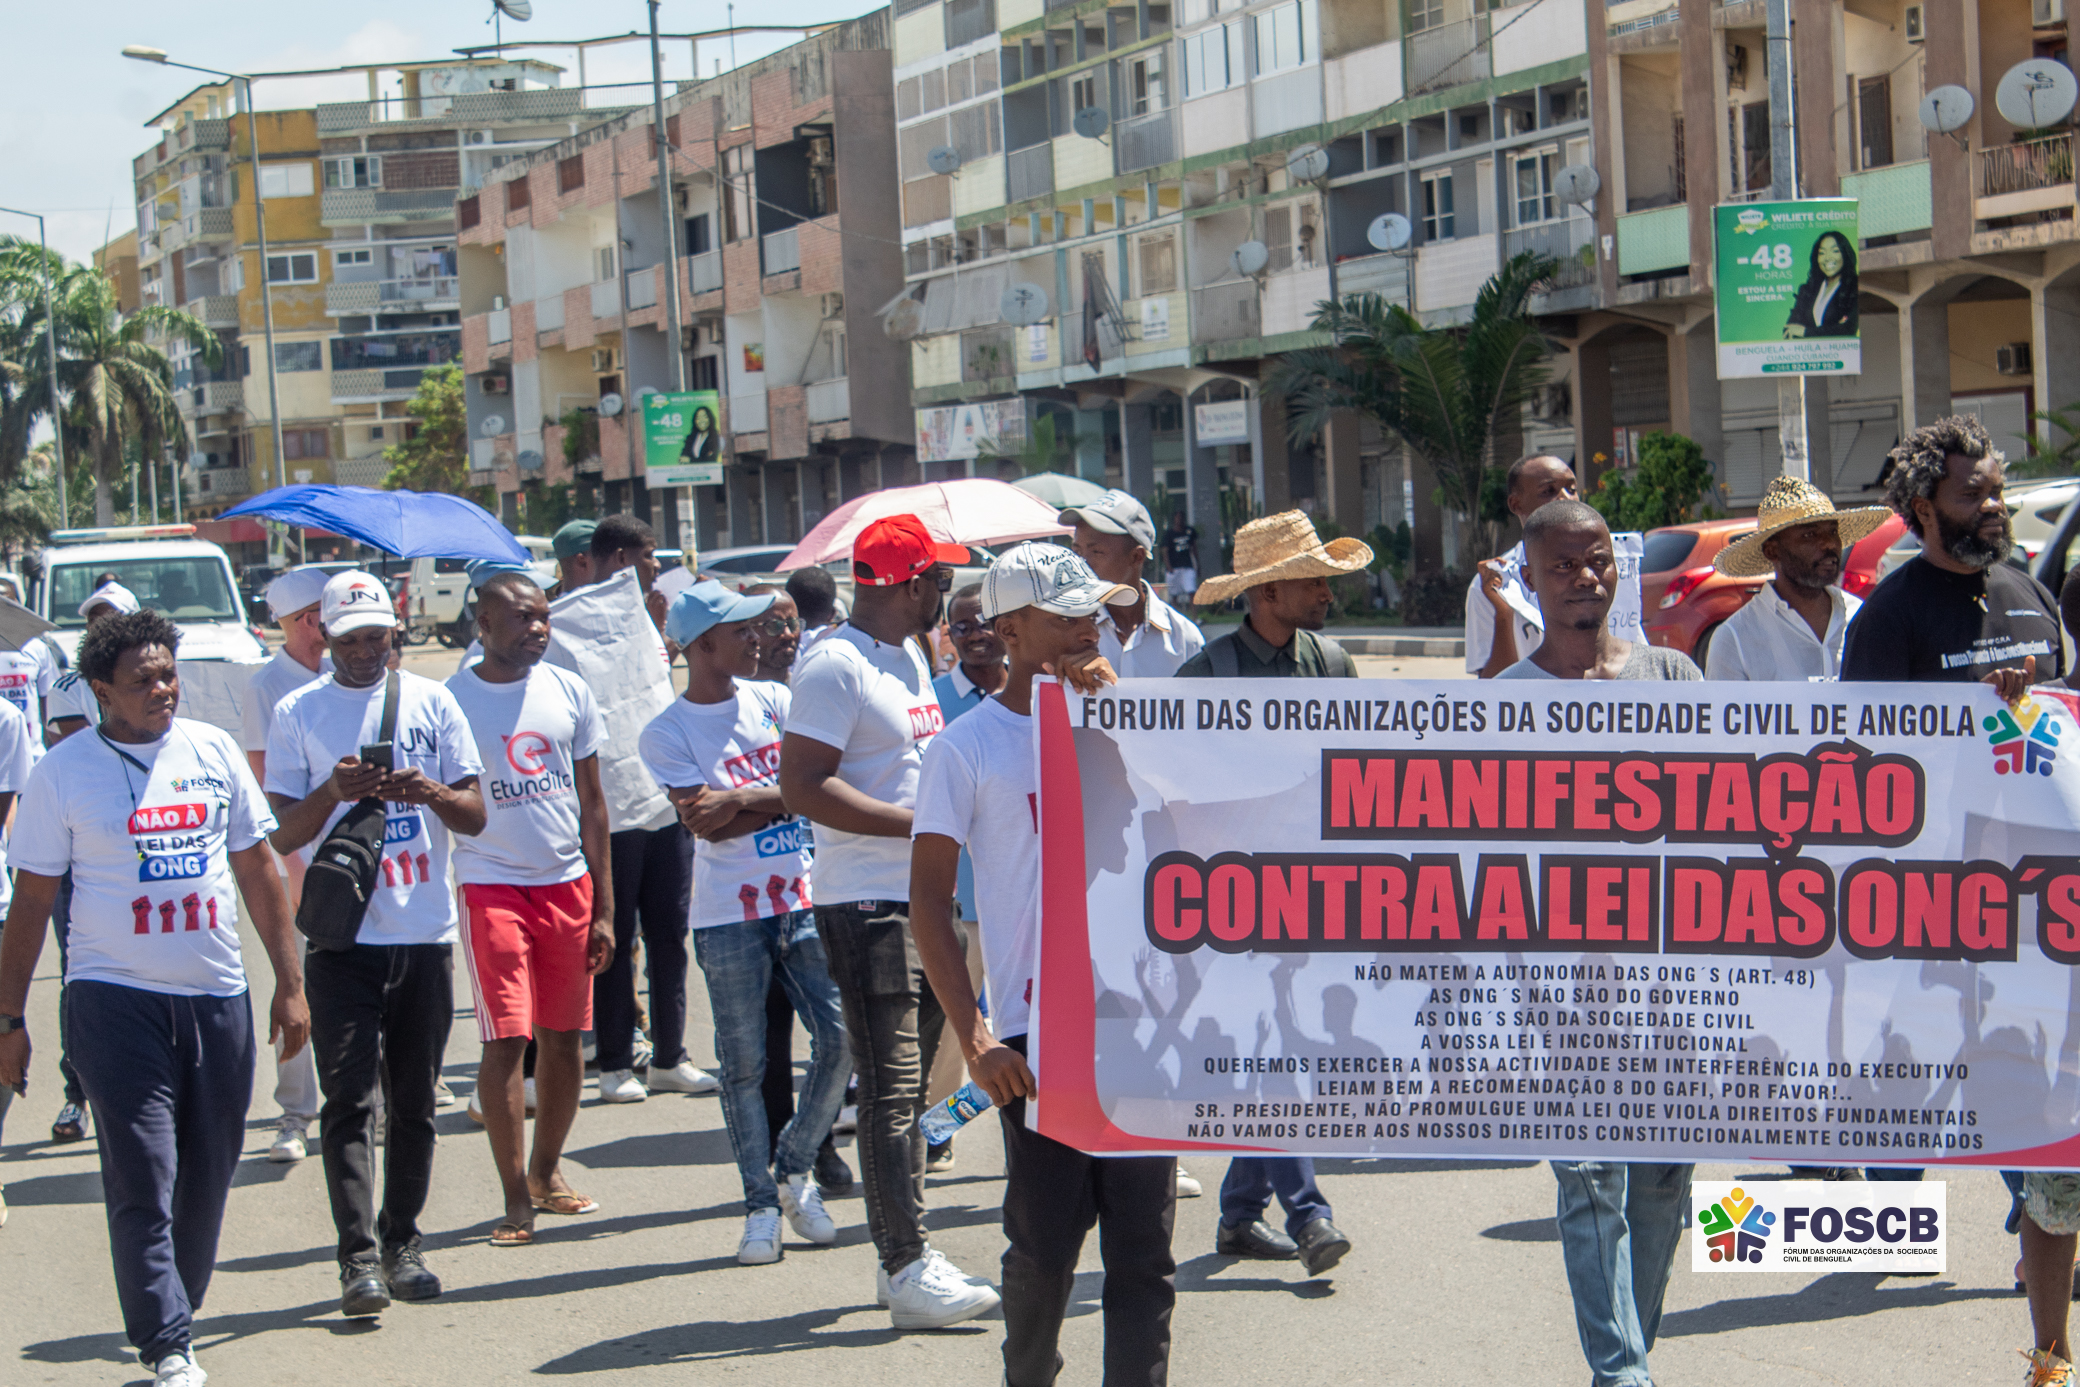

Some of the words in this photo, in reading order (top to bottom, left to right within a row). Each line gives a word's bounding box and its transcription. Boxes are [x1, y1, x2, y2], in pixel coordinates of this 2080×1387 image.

[1771, 212, 1814, 222] WILIETE
[1816, 210, 1856, 221] CRÉDITO
[1736, 243, 1793, 269] -48
[1755, 270, 1793, 280] HORAS
[1737, 286, 1766, 294] ESTOU
[1776, 285, 1793, 293] SER
[1746, 293, 1786, 303] SINCERA.
[1735, 345, 1785, 355] BENGUELA
[1794, 343, 1821, 353] HUÍLA
[1829, 342, 1860, 350] HUAMB
[1766, 353, 1800, 361] CUANDO
[1802, 352, 1839, 360] CUBANGO
[652, 413, 683, 428] -48
[911, 706, 943, 736] NÃO
[1082, 698, 1184, 730] FORUM
[1197, 699, 1251, 730] DAS
[1263, 693, 1487, 740] ORGANIZAÇÕES
[1499, 701, 1536, 732] DA
[1546, 701, 1711, 733] SOCIEDADE
[1723, 703, 1799, 735] CIVIL
[1811, 704, 1847, 735] DE
[1858, 704, 1975, 737] ANGOLA
[401, 728, 437, 753] JN
[729, 747, 780, 785] NÃO
[497, 800, 522, 810] DESIGN
[1331, 751, 1915, 848] MANIFESTAÇÃO
[136, 808, 180, 831] NÃO
[185, 805, 200, 826] À
[385, 822, 411, 839] NG
[171, 835, 207, 850] DAS
[149, 856, 201, 877] ONG
[1153, 864, 1461, 941] CONTRA
[1476, 866, 1529, 940] A
[1549, 867, 1650, 941] LEI
[1673, 868, 1827, 946] DAS
[1355, 962, 1391, 981] NÃO
[1400, 965, 1467, 980] MATEM
[1474, 965, 1485, 980] A
[1493, 965, 1606, 981] AUTONOMIA
[1614, 965, 1649, 981] DAS
[1728, 968, 1776, 987] (ART.
[1784, 970, 1814, 989] 48)
[1429, 988, 1452, 1004] AS
[1529, 984, 1565, 1003] NÃO
[1573, 984, 1608, 1003] SÃO
[1617, 988, 1641, 1004] DO
[1649, 989, 1739, 1006] GOVERNO
[1414, 1011, 1437, 1027] AS
[1514, 1007, 1549, 1026] SÃO
[1557, 1011, 1580, 1026] DA
[1587, 1010, 1695, 1028] SOCIEDADE
[1704, 1013, 1754, 1029] CIVIL
[1421, 1034, 1431, 1049] A
[1438, 1034, 1499, 1049] VOSSA
[1507, 1034, 1534, 1049] LEI
[1543, 1030, 1551, 1049] É
[1560, 1033, 1748, 1052] INCONSTITUCIONAL
[1204, 1057, 1309, 1075] QUEREMOS
[1317, 1057, 1403, 1073] EXERCER
[1410, 1057, 1421, 1072] A
[1428, 1056, 1489, 1073] NOSSA
[1496, 1056, 1610, 1072] ACTIVIDADE
[1618, 1057, 1657, 1073] SEM
[1666, 1057, 1819, 1078] INTERFERÊNCIA
[1827, 1062, 1851, 1078] DO
[1860, 1062, 1968, 1080] EXECUTIVO
[1318, 1080, 1375, 1096] LEIAM
[1383, 1080, 1423, 1095] BEM
[1430, 1080, 1440, 1094] A
[1448, 1076, 1605, 1098] RECOMENDAÇÃO
[1613, 1080, 1623, 1095] 8
[1631, 1080, 1655, 1096] DO
[1664, 1081, 1713, 1100] GAFI,
[1722, 1082, 1759, 1098] POR
[1195, 1103, 1225, 1118] SR.
[1233, 1103, 1356, 1119] PRESIDENTE,
[1365, 1099, 1401, 1116] NÃO
[1409, 1100, 1525, 1116] PROMULGUE
[1534, 1101, 1575, 1117] UMA
[1583, 1102, 1610, 1118] LEI
[1619, 1103, 1655, 1120] QUE
[1663, 1104, 1719, 1120] VIOLA
[1728, 1105, 1817, 1122] DIREITOS
[1825, 1107, 1976, 1126] FUNDAMENTAIS
[1188, 1121, 1224, 1137] NÃO
[1232, 1123, 1298, 1138] VAMOS
[1305, 1124, 1366, 1138] CEDER
[1374, 1123, 1409, 1138] AOS
[1417, 1123, 1491, 1139] NOSSOS
[1499, 1124, 1588, 1140] DIREITOS
[1596, 1125, 1830, 1145] CONSTITUCIONALMENTE
[1839, 1130, 1982, 1149] CONSAGRADOS
